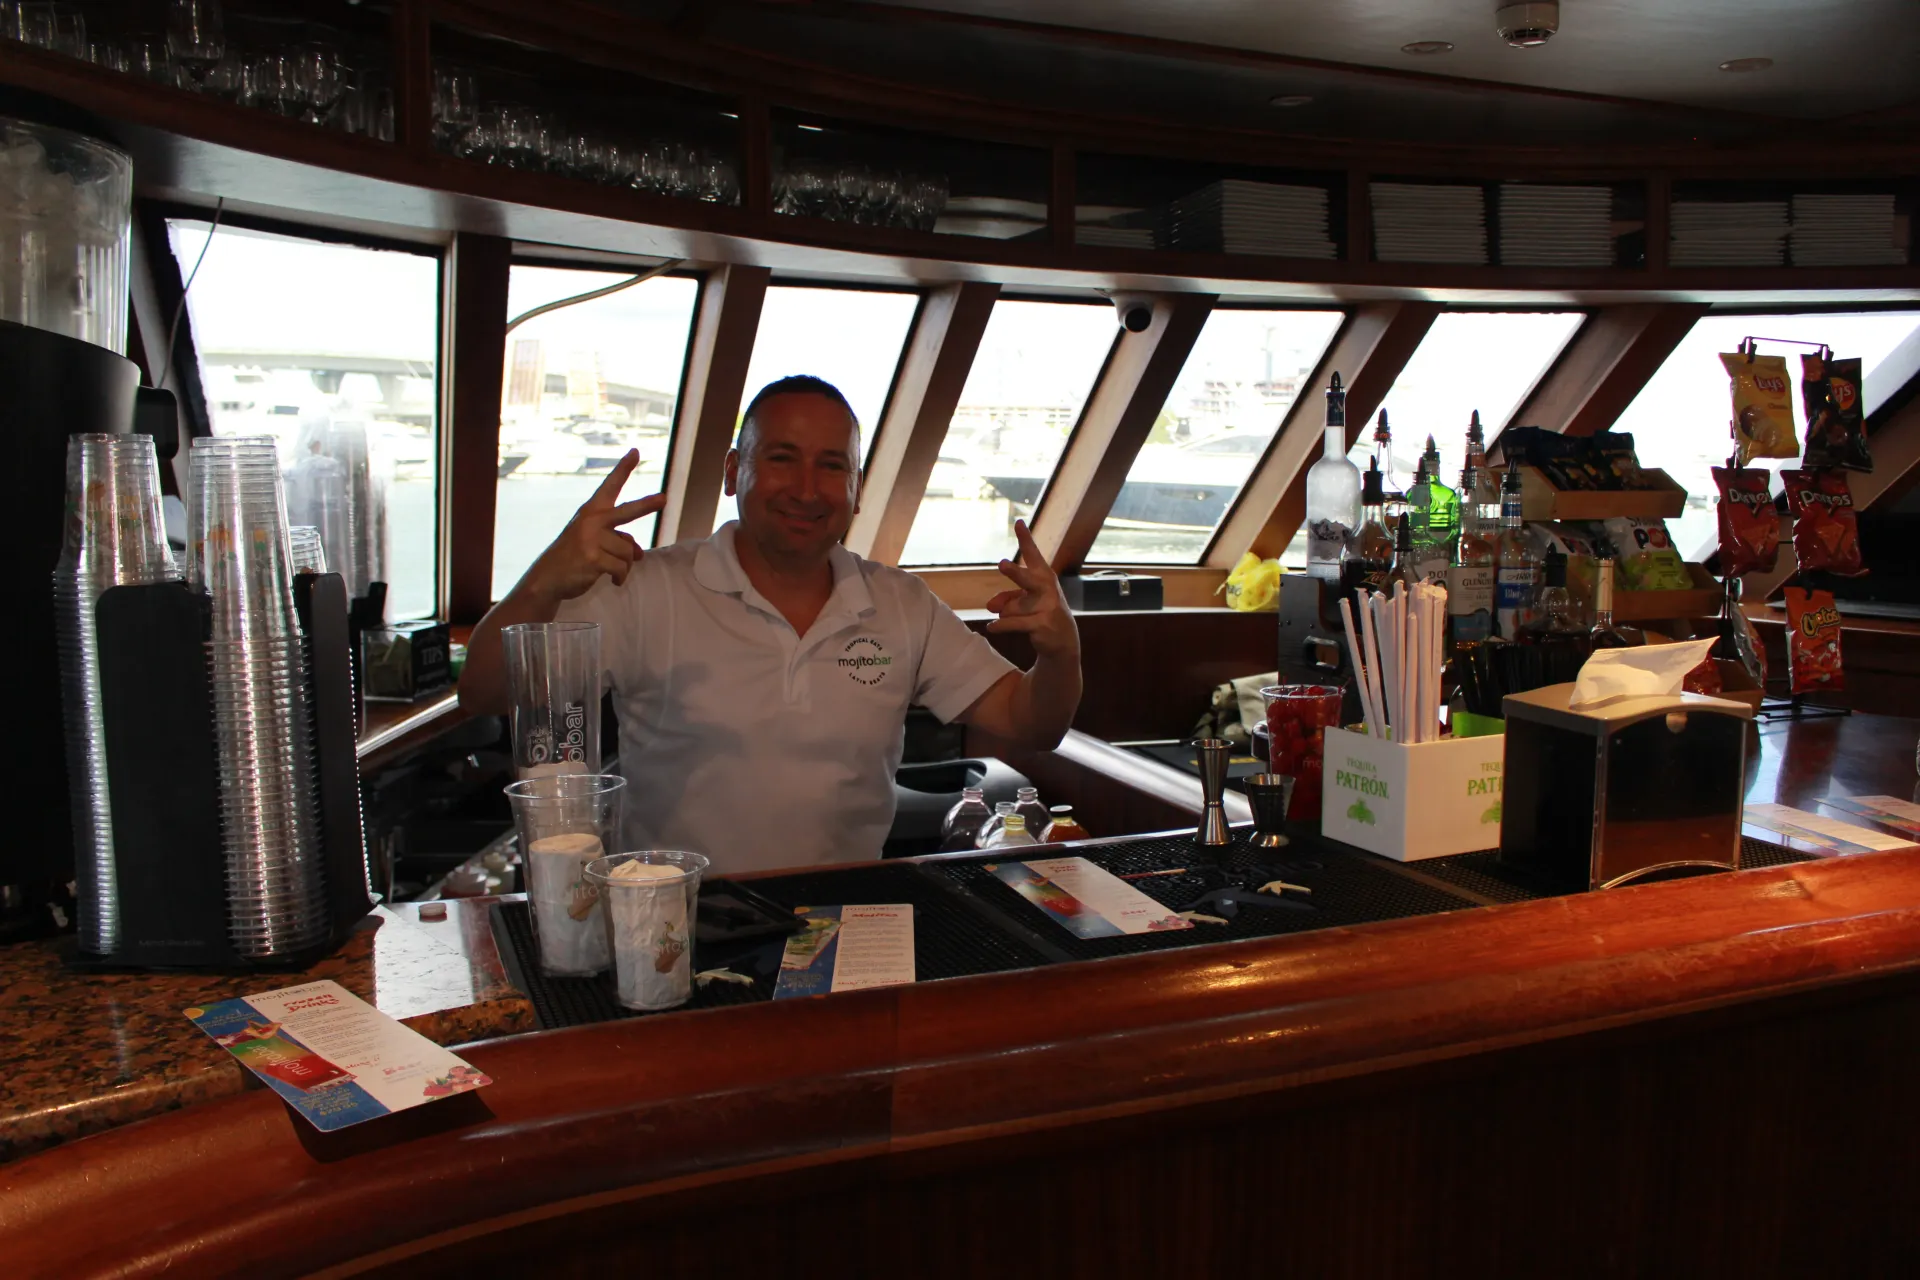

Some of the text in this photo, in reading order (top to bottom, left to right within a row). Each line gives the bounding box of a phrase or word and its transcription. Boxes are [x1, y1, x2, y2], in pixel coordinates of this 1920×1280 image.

[845, 637, 868, 652] TROPICAL
[838, 653, 892, 669] mojitobar
[558, 701, 584, 763] obar
[1346, 756, 1377, 773] TEQUILA
